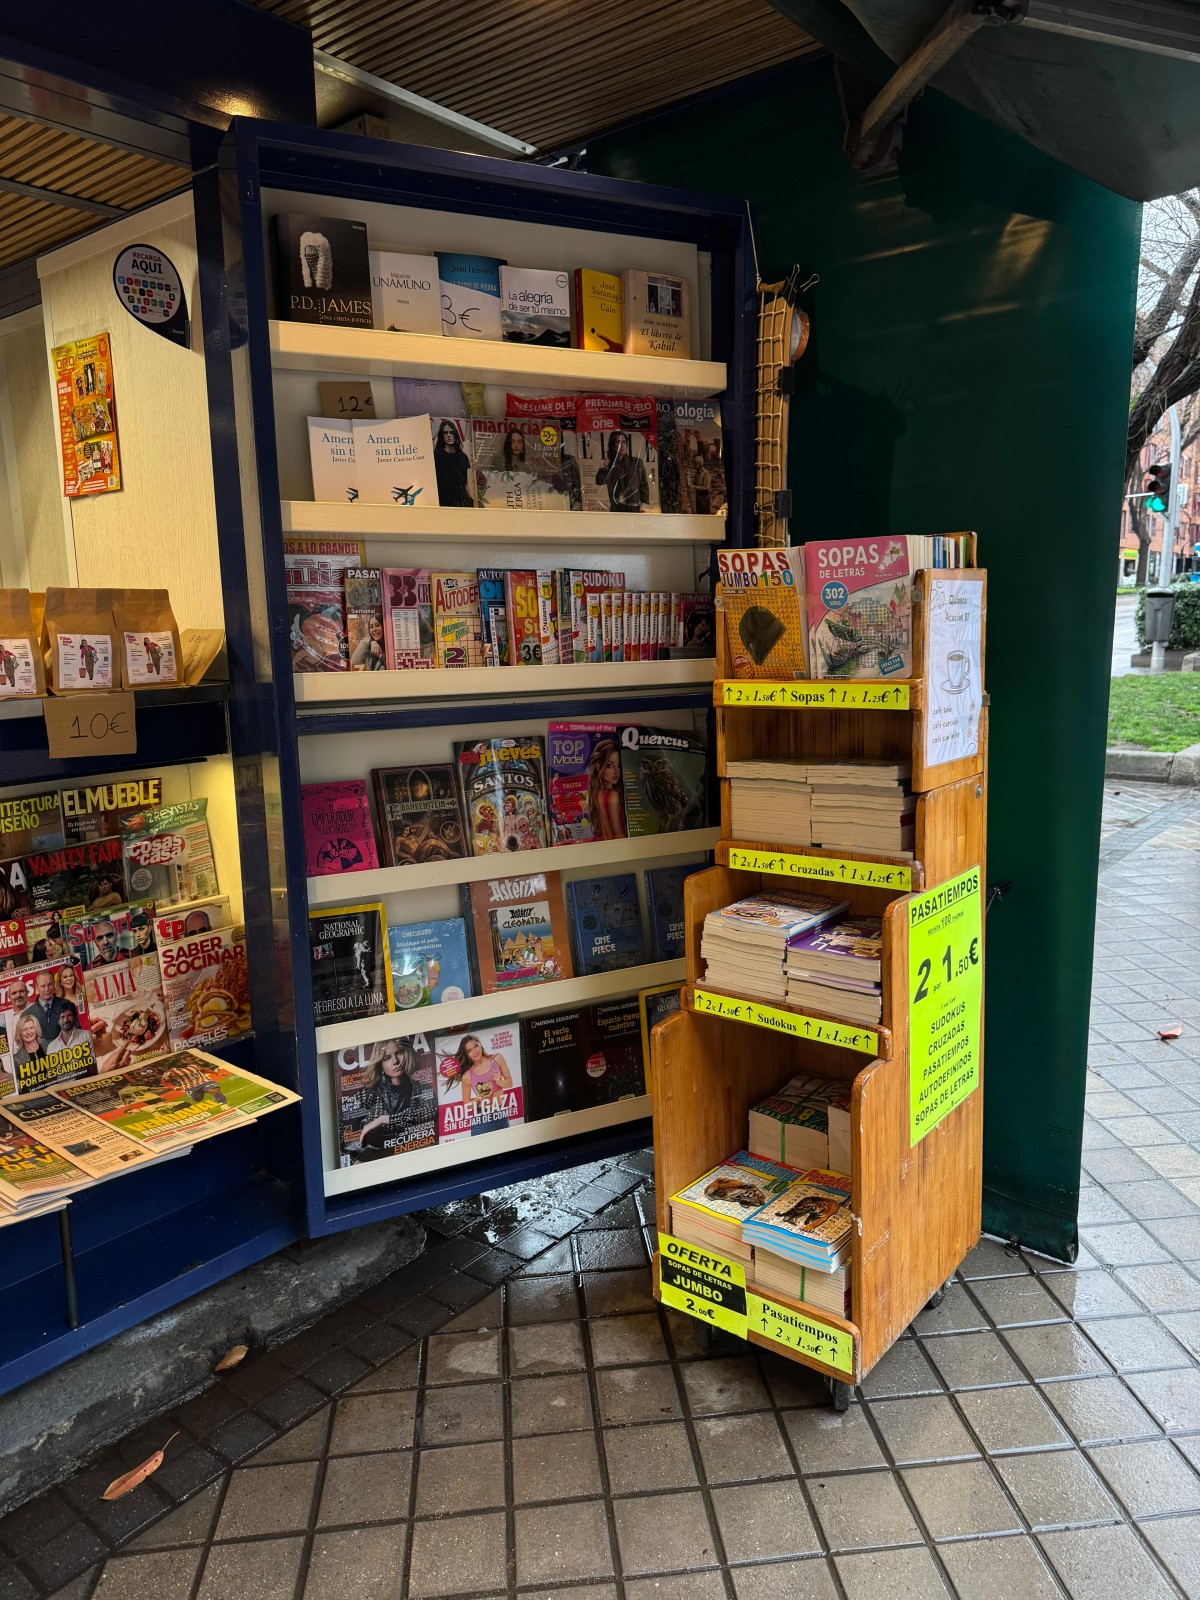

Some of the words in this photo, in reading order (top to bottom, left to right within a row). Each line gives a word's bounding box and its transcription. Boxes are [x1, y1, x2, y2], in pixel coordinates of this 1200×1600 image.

[132, 251, 162, 263] RECARGA
[450, 264, 467, 273] Juan
[468, 266, 494, 276] Herrera
[372, 276, 431, 291] UNAMUNO
[599, 280, 616, 291] José
[290, 295, 317, 310] P.D.
[321, 298, 372, 315] JAMES
[508, 290, 518, 301] La
[518, 290, 553, 306] alegría
[441, 294, 482, 333] 3€
[508, 301, 518, 312] de
[518, 305, 530, 313] ser
[540, 307, 567, 316] mismo
[650, 329, 673, 339] librero
[674, 332, 683, 341] de
[648, 340, 675, 352] Kabul
[337, 395, 374, 413] 12€
[555, 402, 565, 411] DE
[585, 398, 624, 410] PRESUME
[472, 418, 513, 434] marie
[592, 418, 614, 429] one
[366, 433, 400, 444] Amen
[330, 445, 346, 456] sin
[375, 445, 391, 456] sin
[395, 445, 418, 456] tilde
[305, 542, 317, 555] LO
[319, 542, 359, 555] GRANDE!
[817, 543, 881, 569] SOPAS
[718, 551, 791, 574] SOPAS
[583, 572, 625, 587] SUDOKU
[721, 571, 760, 589] JUMBO
[759, 569, 794, 588] 150
[819, 569, 831, 579] DE
[832, 567, 866, 578] LETRAS
[824, 587, 845, 600] 302
[446, 647, 466, 664] 2
[736, 689, 743, 701] 2
[744, 694, 750, 702] x
[753, 689, 777, 702] 1.50€
[790, 690, 825, 705] Sopas
[840, 690, 848, 703] 1
[850, 695, 857, 703] x
[862, 689, 890, 703] 1.25€
[69, 711, 129, 739] 10€
[603, 724, 613, 732] the
[552, 739, 585, 756] TOP
[621, 727, 690, 751] Quercus
[479, 745, 542, 767] jueves
[552, 754, 585, 766] Model
[473, 772, 536, 794] SANTOS
[562, 781, 583, 790] TALITA
[146, 812, 155, 824] 2
[154, 800, 200, 822] REVISTAS
[311, 809, 356, 827] EMPERADOR
[389, 800, 446, 821] FRANKENSTEIN
[27, 850, 87, 878] VANITY
[89, 838, 123, 867] FAIR
[789, 862, 835, 878] Cruzadas
[850, 868, 857, 880] 1
[866, 869, 895, 884] 1.25€
[487, 873, 547, 903] Astérix
[911, 873, 978, 925] PASATIEMPOS
[508, 906, 535, 919] Astérix
[941, 913, 952, 927] 100
[157, 917, 185, 942] tp
[323, 919, 361, 929] NATIONAL
[502, 916, 547, 929] CLEOPATRA
[668, 922, 686, 932] ONE
[318, 925, 366, 941] GEOGRAPHIC
[594, 935, 612, 945] ONE
[161, 935, 222, 965] SABER
[591, 943, 617, 955] PIECE
[162, 944, 246, 979] COCINAR
[913, 957, 932, 1005] 2
[933, 982, 942, 994] por
[942, 937, 979, 984] 1.50€
[93, 969, 137, 1004] ALMA
[313, 996, 348, 1015] REGRESO
[348, 997, 355, 1008] A
[354, 995, 364, 1007] LA
[363, 992, 385, 1006] LUNA
[601, 1005, 620, 1014] NATIONAL
[535, 1018, 555, 1028] NATIONAL
[555, 1013, 580, 1024] GEOGRAPHIC
[608, 1020, 636, 1032] cuántico
[930, 1003, 966, 1035] SUDOKUS
[543, 1029, 551, 1038] El
[551, 1026, 570, 1037] vacío
[757, 1012, 797, 1032] Sudokus
[816, 1026, 823, 1038] 1
[831, 1029, 861, 1046] 1.25€
[173, 1026, 228, 1052] PASTELES
[541, 1039, 547, 1048] y
[547, 1037, 556, 1045] la
[555, 1033, 573, 1043] nada
[927, 1020, 965, 1057] CRUZADAS
[19, 1042, 91, 1079] HUNDIDOS
[922, 1035, 969, 1081] PASATIEMPOS
[19, 1075, 38, 1090] POR
[38, 1071, 48, 1083] EL
[65, 1075, 124, 1097] MUNDO
[918, 1050, 972, 1104] AUTODEFINIDOS
[341, 1094, 357, 1105] Piel
[914, 1102, 939, 1126] SOPAS
[939, 1093, 950, 1109] DE
[949, 1066, 975, 1099] LETRAS
[126, 1099, 222, 1134] VENDAVAL
[443, 1091, 519, 1125] ADELGAZA
[443, 1122, 458, 1132] SIN
[458, 1117, 483, 1131] DEJAR
[482, 1115, 492, 1125] DE
[492, 1107, 519, 1122] COMER
[383, 1127, 436, 1149] RECUPERA
[666, 1242, 733, 1278] OFERTA
[667, 1259, 692, 1275] SOPAS
[691, 1268, 703, 1278] DE
[703, 1273, 733, 1291] LETRAS
[672, 1274, 724, 1303] JUMBO
[685, 1297, 716, 1320] 2.00€
[761, 1302, 839, 1345] Pasatiempos
[775, 1326, 783, 1338] 2
[785, 1334, 792, 1343] x
[795, 1336, 824, 1356] 1.50€
